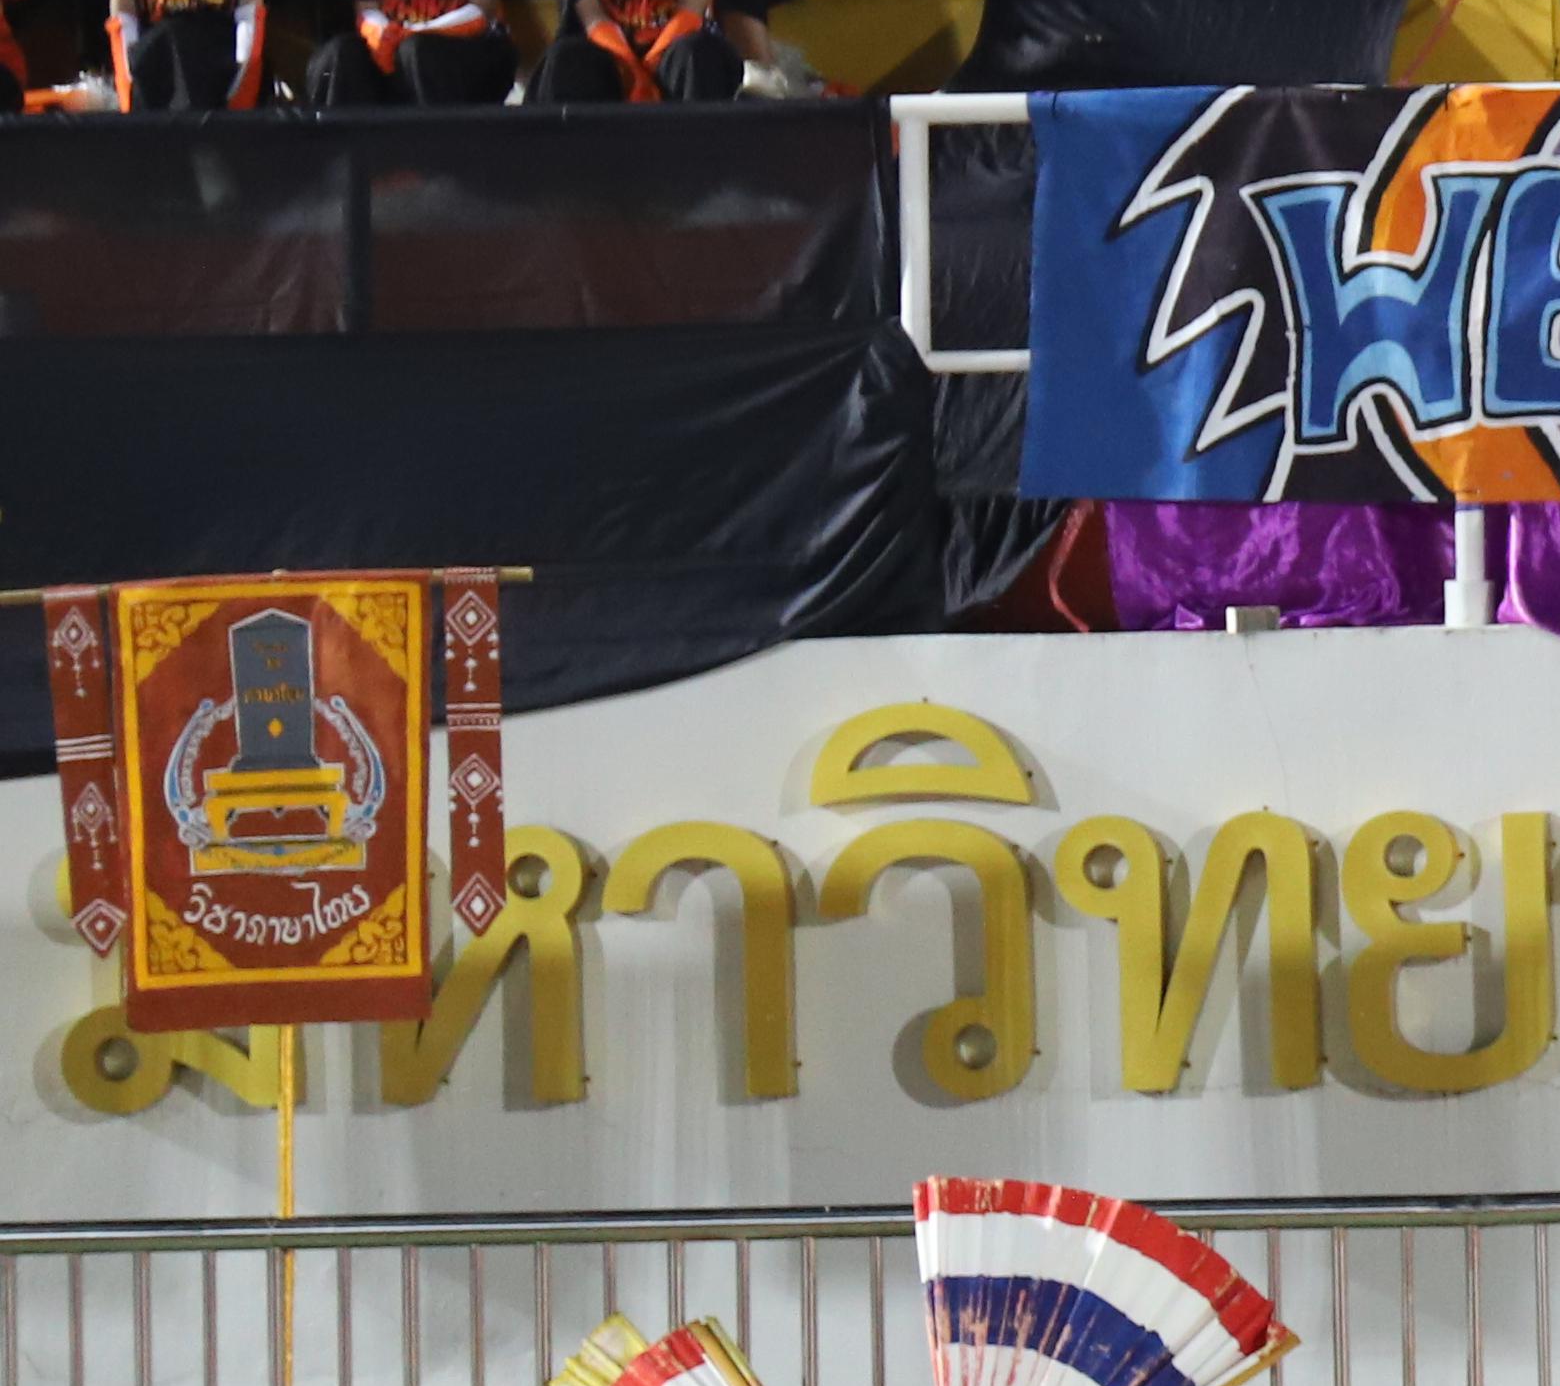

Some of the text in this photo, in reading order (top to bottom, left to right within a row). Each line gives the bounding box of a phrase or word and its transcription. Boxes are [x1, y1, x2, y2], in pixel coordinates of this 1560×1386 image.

[183, 881, 373, 947] วิชาภาษาไทย
